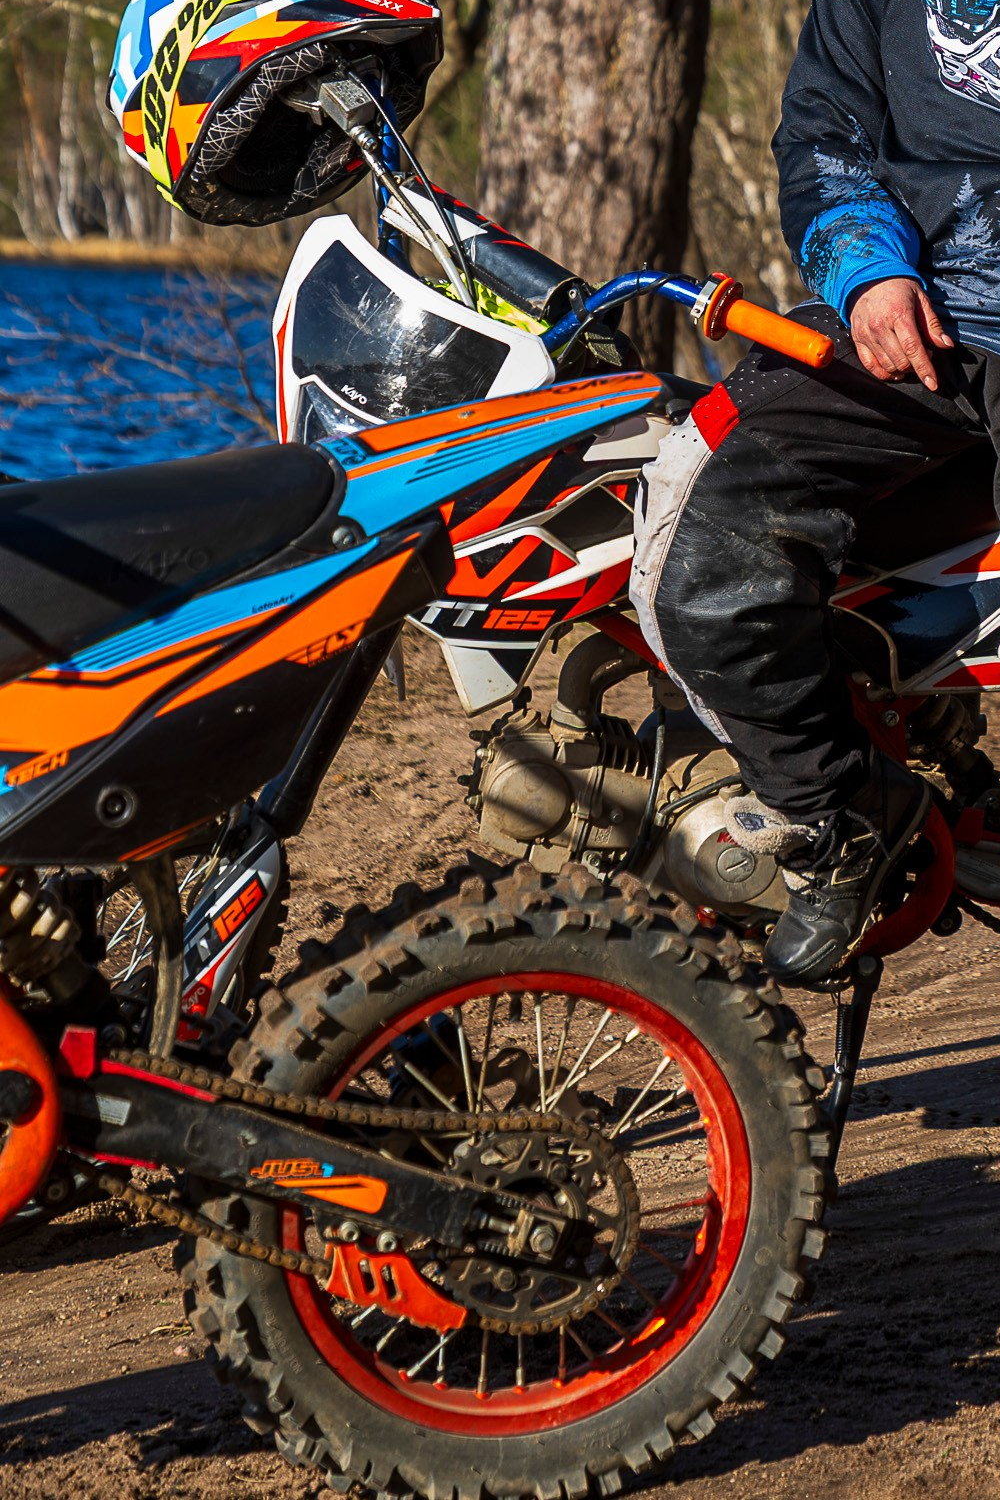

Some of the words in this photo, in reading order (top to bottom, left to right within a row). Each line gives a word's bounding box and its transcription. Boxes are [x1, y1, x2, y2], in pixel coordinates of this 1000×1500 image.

[420, 601, 489, 628] TT
[482, 609, 556, 631] 125
[212, 878, 264, 943] 125
